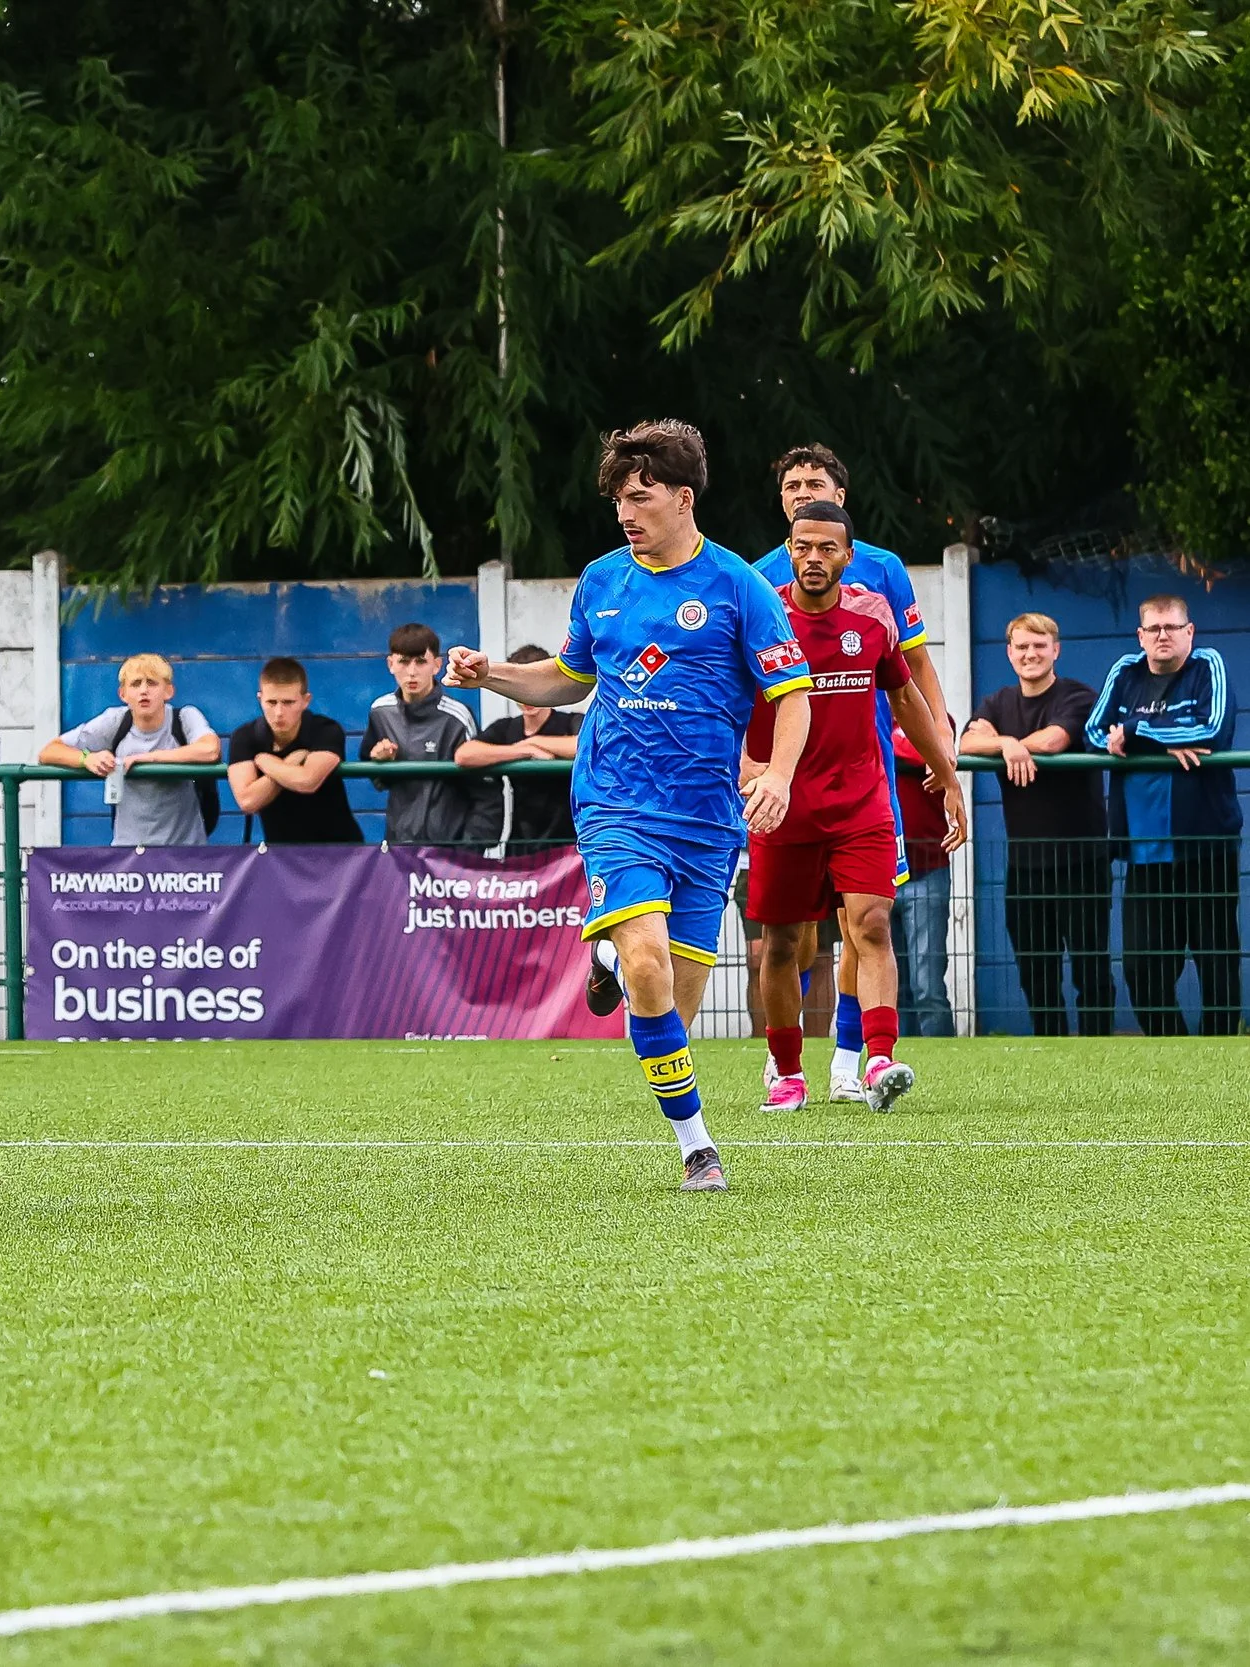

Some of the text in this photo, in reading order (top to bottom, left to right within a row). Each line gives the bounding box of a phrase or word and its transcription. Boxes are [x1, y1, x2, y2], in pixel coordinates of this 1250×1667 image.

[815, 674, 871, 689] Bathroom
[618, 697, 678, 711] Domino's
[50, 872, 224, 893] HAYWARD WRIGHT
[408, 872, 538, 899] More than
[52, 898, 218, 914] Accountancy & Advisory
[403, 901, 456, 934] just
[51, 937, 263, 969] On the side of
[54, 974, 265, 1022] business
